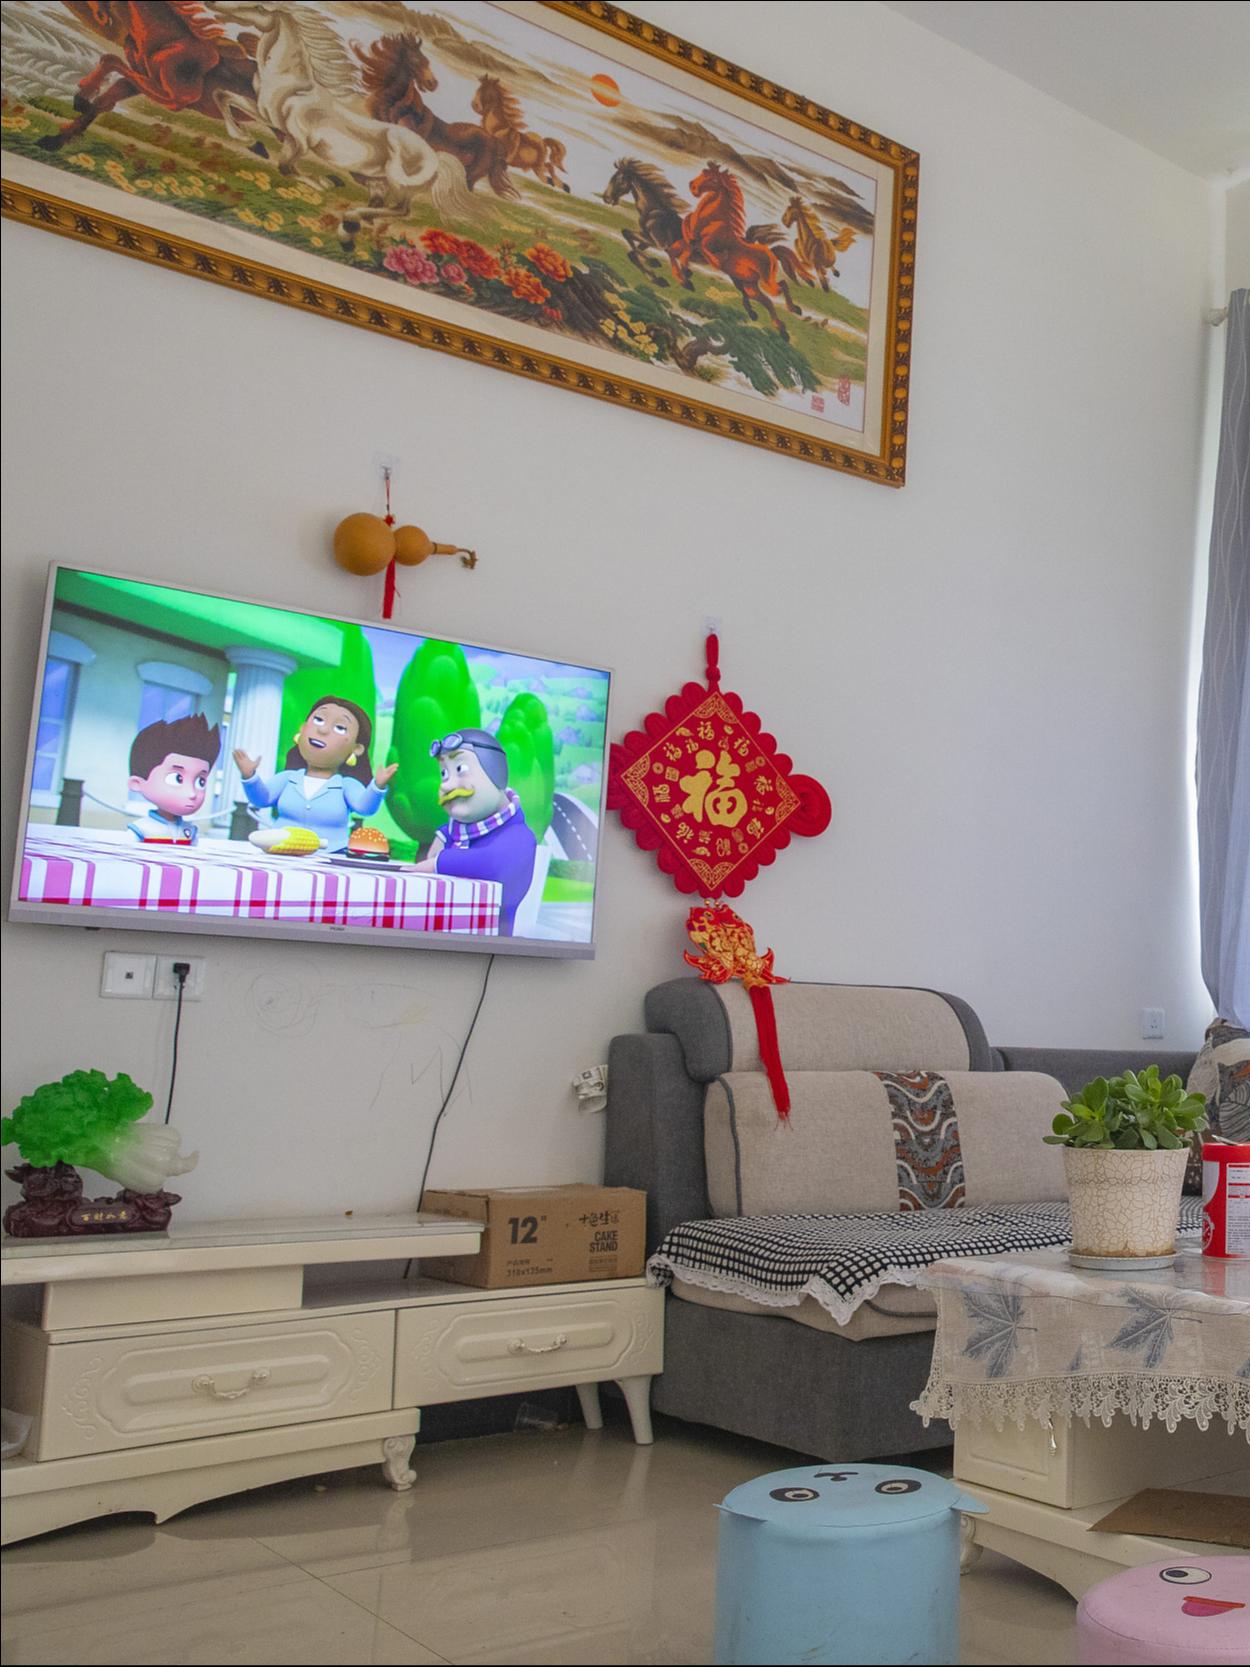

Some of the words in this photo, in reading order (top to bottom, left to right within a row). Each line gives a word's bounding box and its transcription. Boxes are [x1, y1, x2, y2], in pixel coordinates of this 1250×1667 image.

[679, 749, 748, 828] 福
[594, 1230, 618, 1242] CAKE
[590, 1240, 618, 1253] STAND
